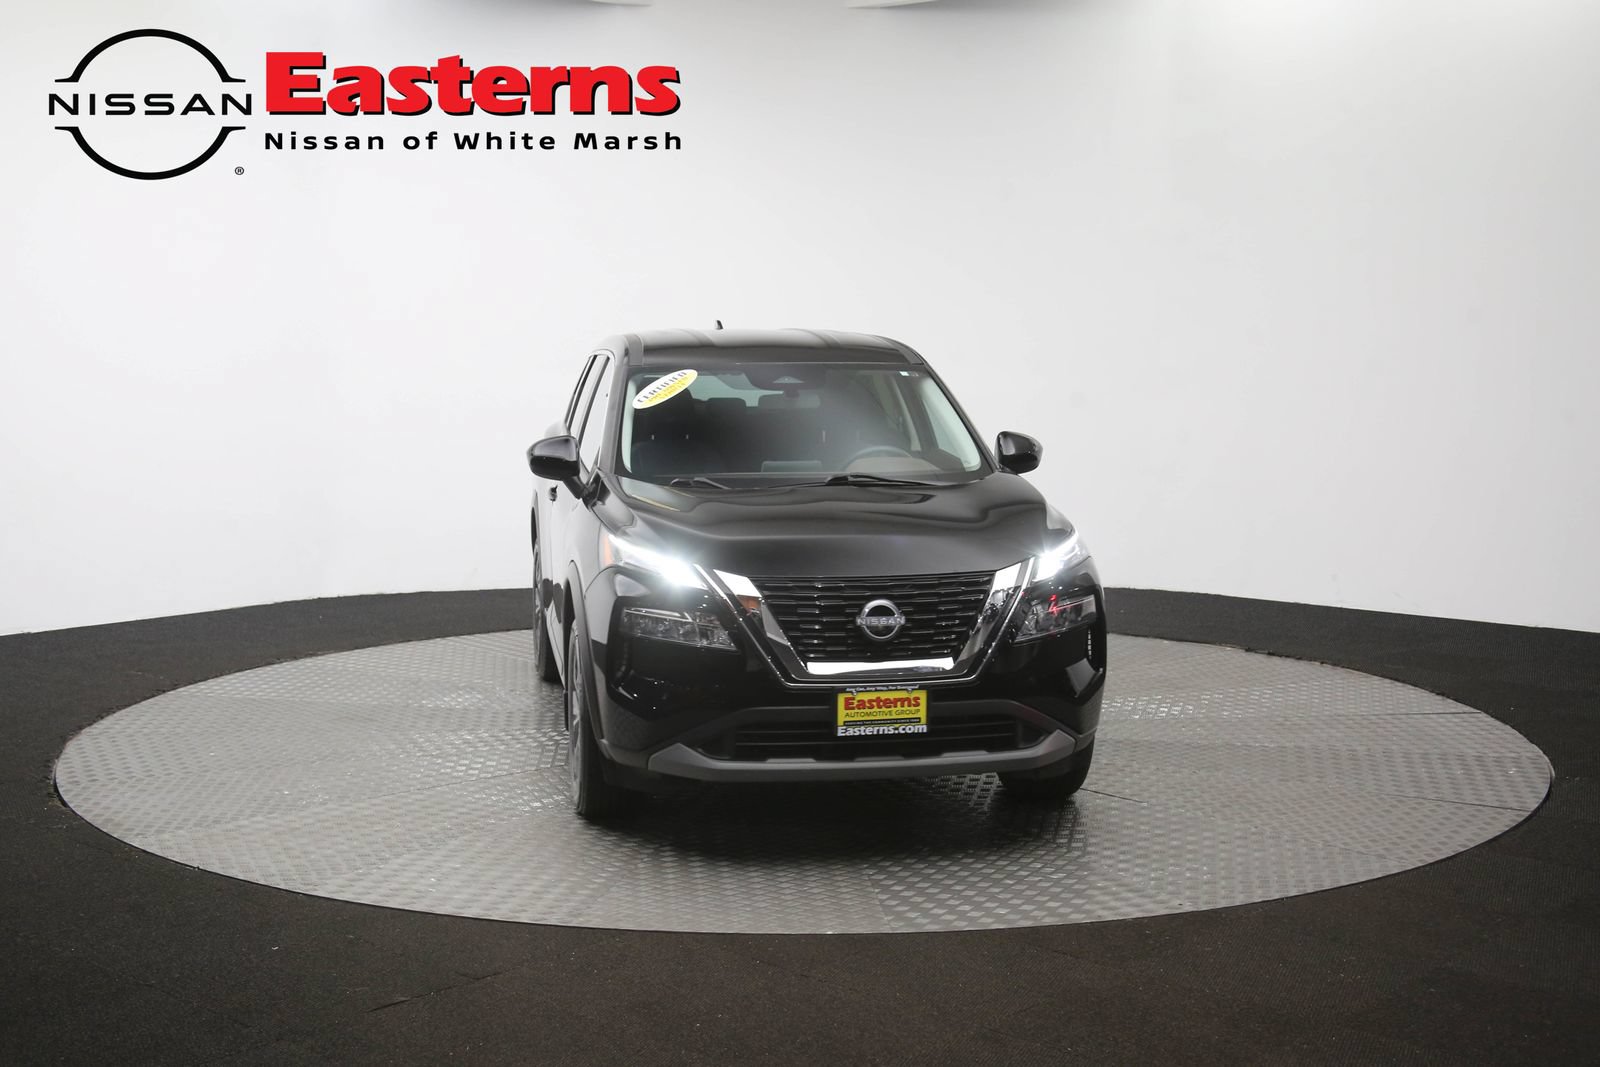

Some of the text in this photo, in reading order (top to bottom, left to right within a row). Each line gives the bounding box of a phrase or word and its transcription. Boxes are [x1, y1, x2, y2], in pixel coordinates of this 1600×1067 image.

[856, 616, 905, 625] NISSAN
[844, 696, 921, 710] Easterns
[844, 708, 921, 718] AUTOMOTIVE GROUP
[837, 725, 927, 736] Easterns.com
